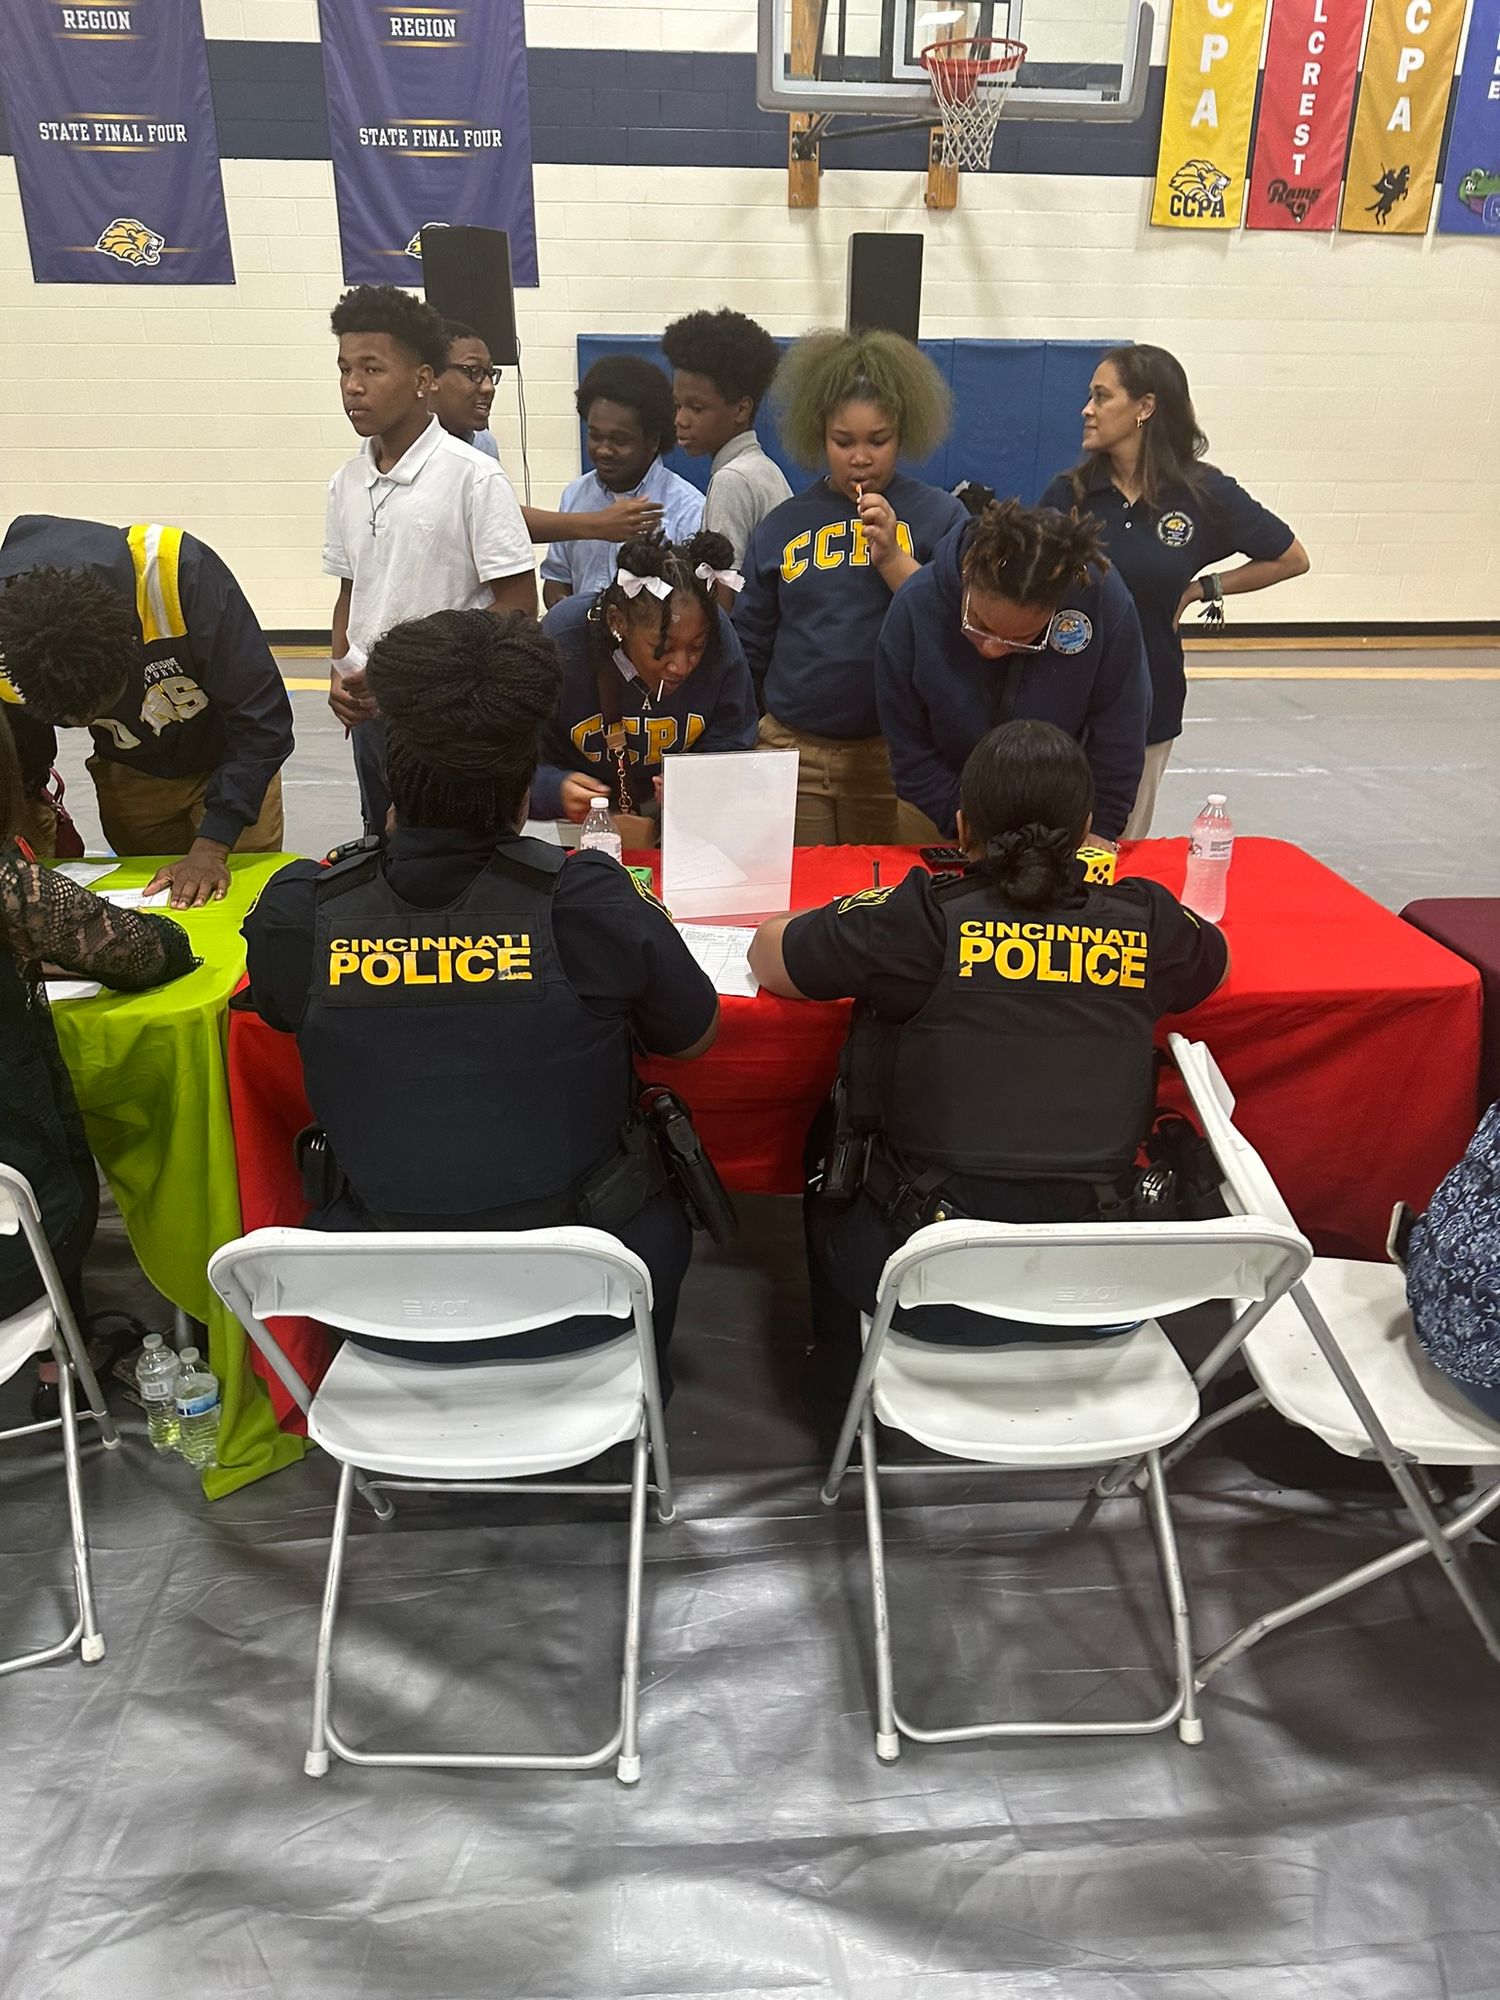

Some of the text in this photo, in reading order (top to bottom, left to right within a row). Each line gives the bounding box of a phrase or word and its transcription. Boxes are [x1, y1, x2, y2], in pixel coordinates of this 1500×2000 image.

[62, 9, 131, 30] REGION
[390, 17, 456, 37] REGION
[38, 122, 188, 142] STATE FINAL FOUR
[359, 128, 503, 148] STATE FINAL FOUR
[1170, 194, 1226, 218] CCPA
[329, 934, 530, 953] CINCINNATI
[959, 921, 1148, 948] CINCINNATI
[329, 947, 533, 986] POLICE
[958, 936, 1148, 989] POLICE
